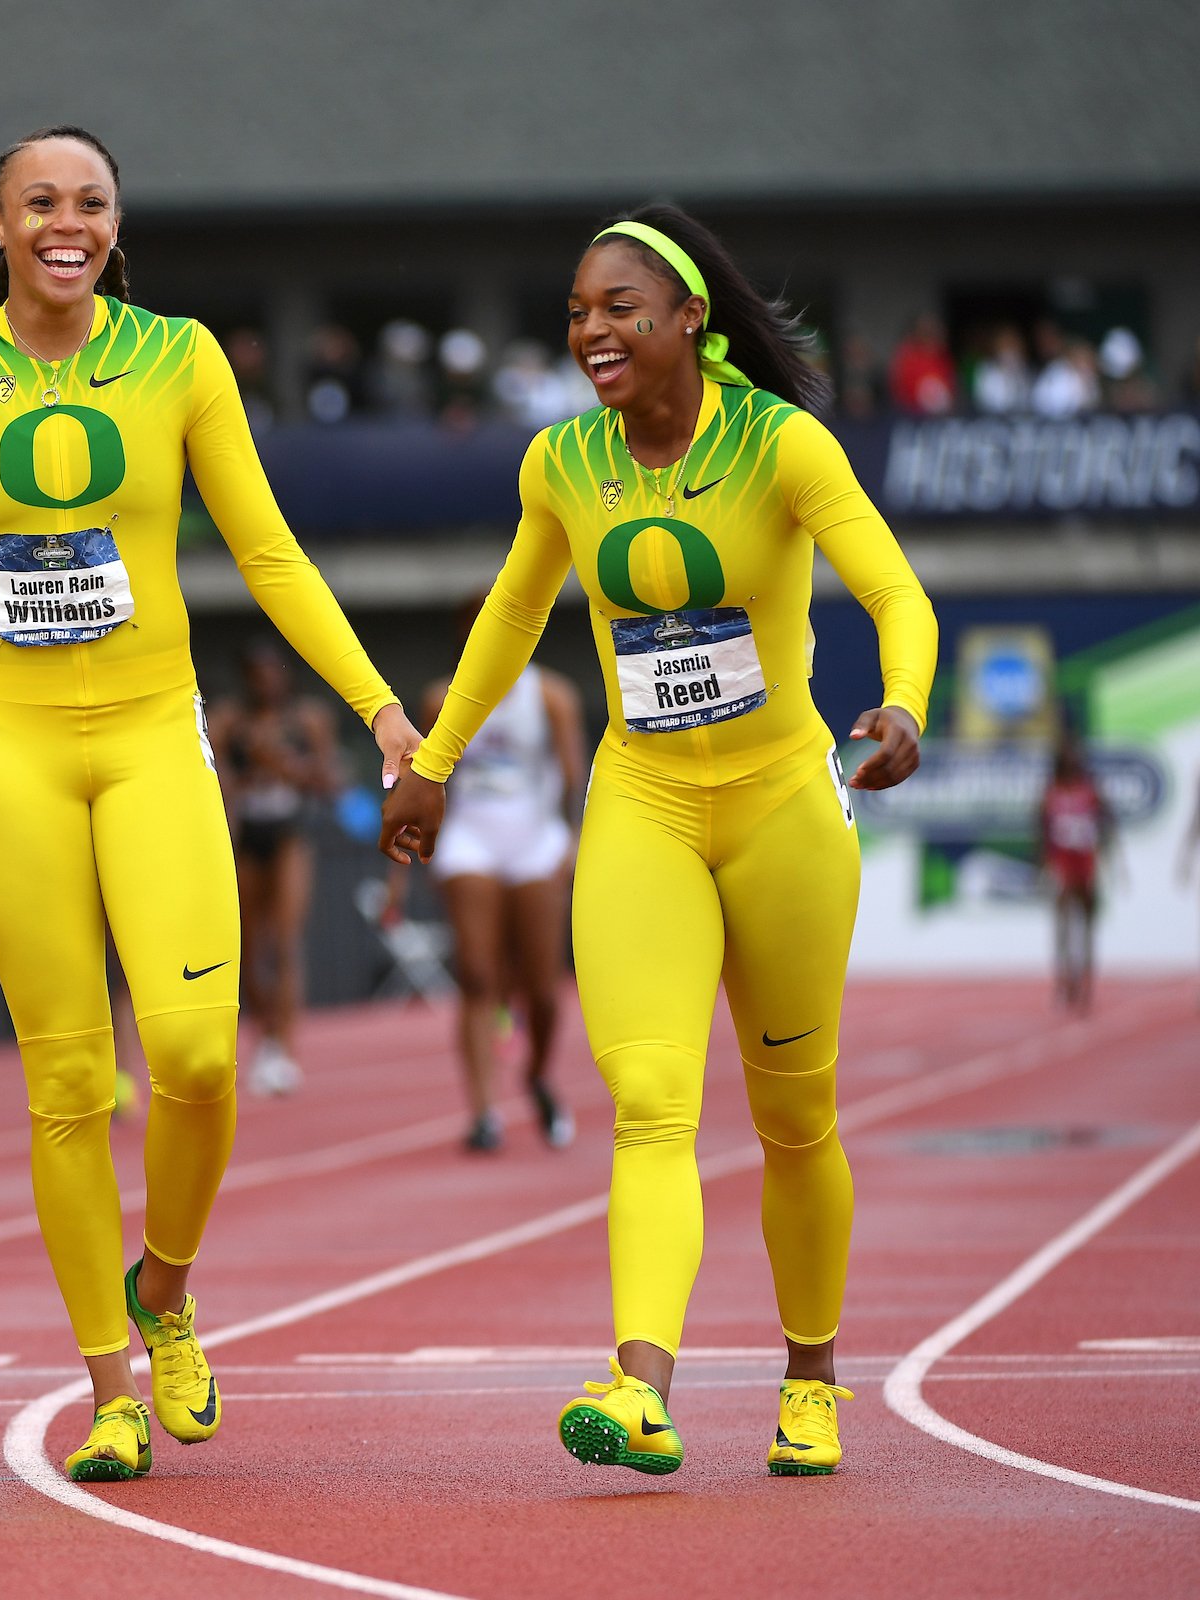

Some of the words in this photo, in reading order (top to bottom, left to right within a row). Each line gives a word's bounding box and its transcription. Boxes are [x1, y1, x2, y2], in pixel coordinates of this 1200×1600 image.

[883, 414, 1200, 511] HISTORIC
[602, 481, 623, 497] PAC
[605, 494, 616, 504] 12
[597, 517, 726, 616] O
[10, 578, 64, 596] Lauren
[69, 574, 105, 594] Rain
[4, 597, 116, 624] Williams
[13, 631, 49, 642] HAYWARD
[50, 631, 70, 640] FIELD
[80, 629, 100, 639] JUNE
[654, 653, 712, 677] Jasmin
[654, 673, 722, 709] Reed
[646, 718, 681, 729] HAYWARD
[681, 713, 702, 725] FIELD
[710, 707, 731, 719] JUNE
